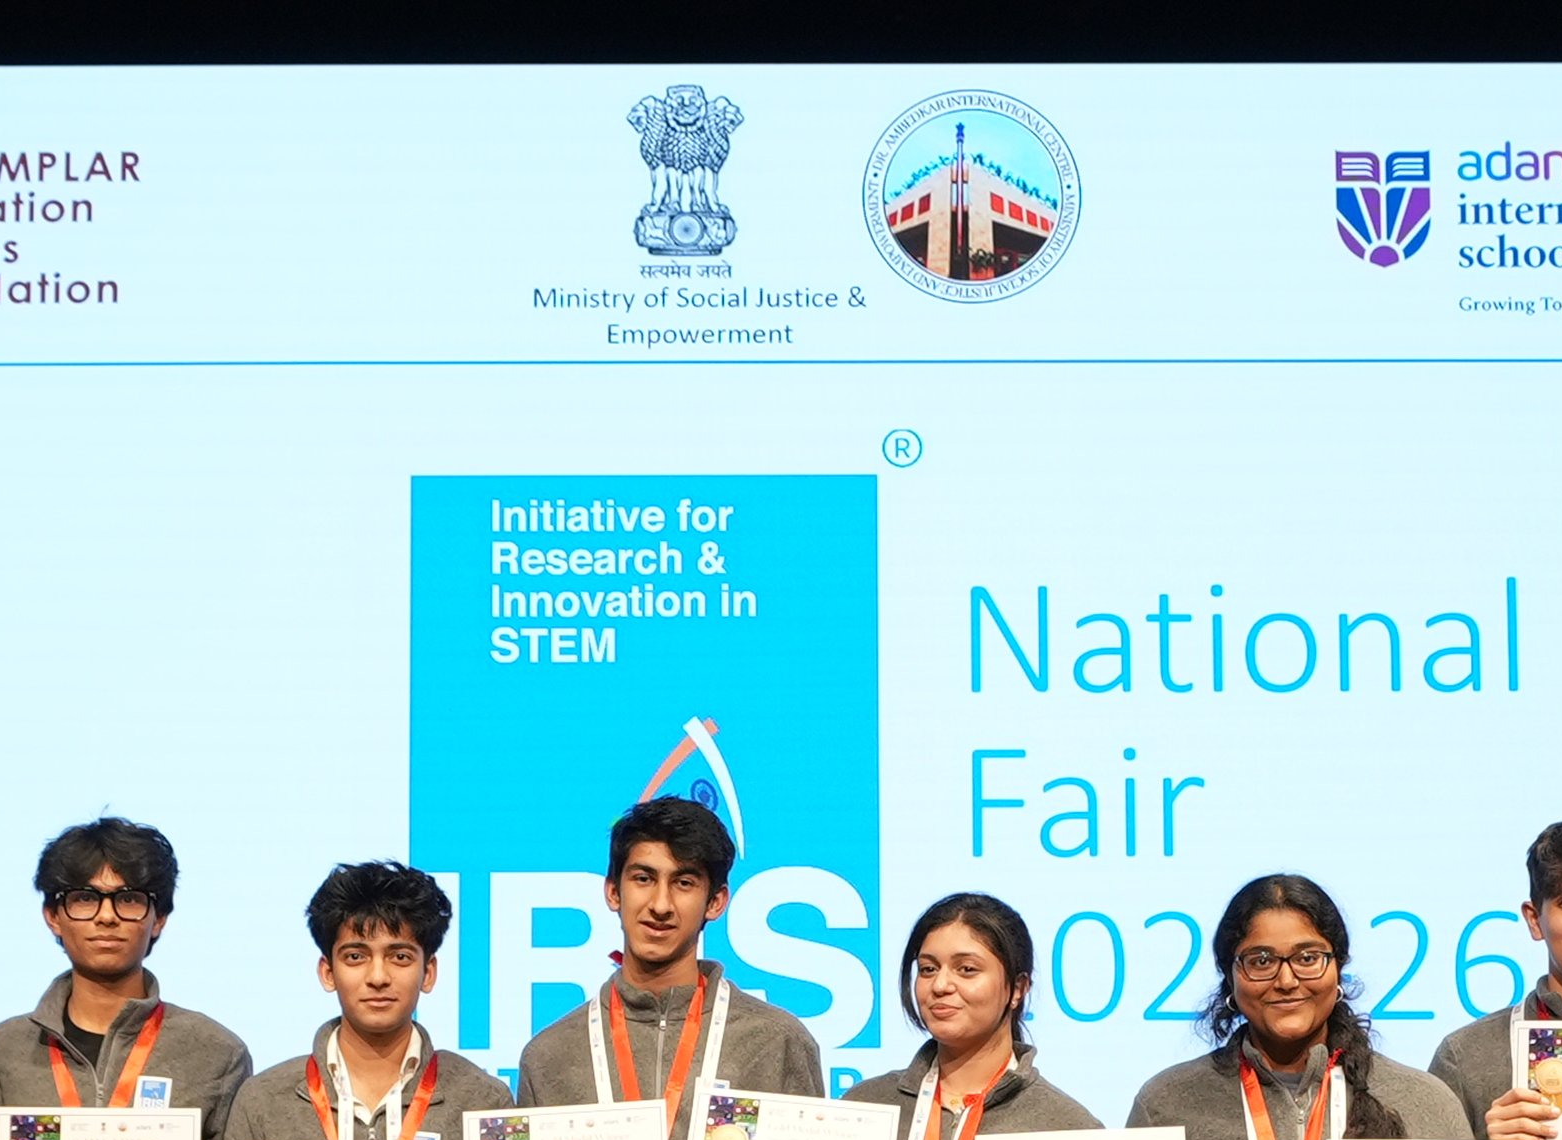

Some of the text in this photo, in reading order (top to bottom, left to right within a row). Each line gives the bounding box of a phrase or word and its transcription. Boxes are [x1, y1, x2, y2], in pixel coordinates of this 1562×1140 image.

[946, 94, 1044, 136] INTERNATIONAL
[1042, 132, 1075, 182] CENTRE
[639, 263, 732, 280] सत्यमेव जयते
[533, 287, 867, 313] Ministry of Social Justice &
[1458, 296, 1536, 316] Growing
[606, 323, 793, 348] Empowerment
[490, 497, 734, 533] Initiative for
[490, 540, 727, 576] Research &
[490, 583, 757, 619] Innovation in
[490, 627, 617, 664] STEM
[968, 576, 1522, 695] National
[969, 745, 1206, 858] Fair
[412, 866, 873, 1050] IRS
